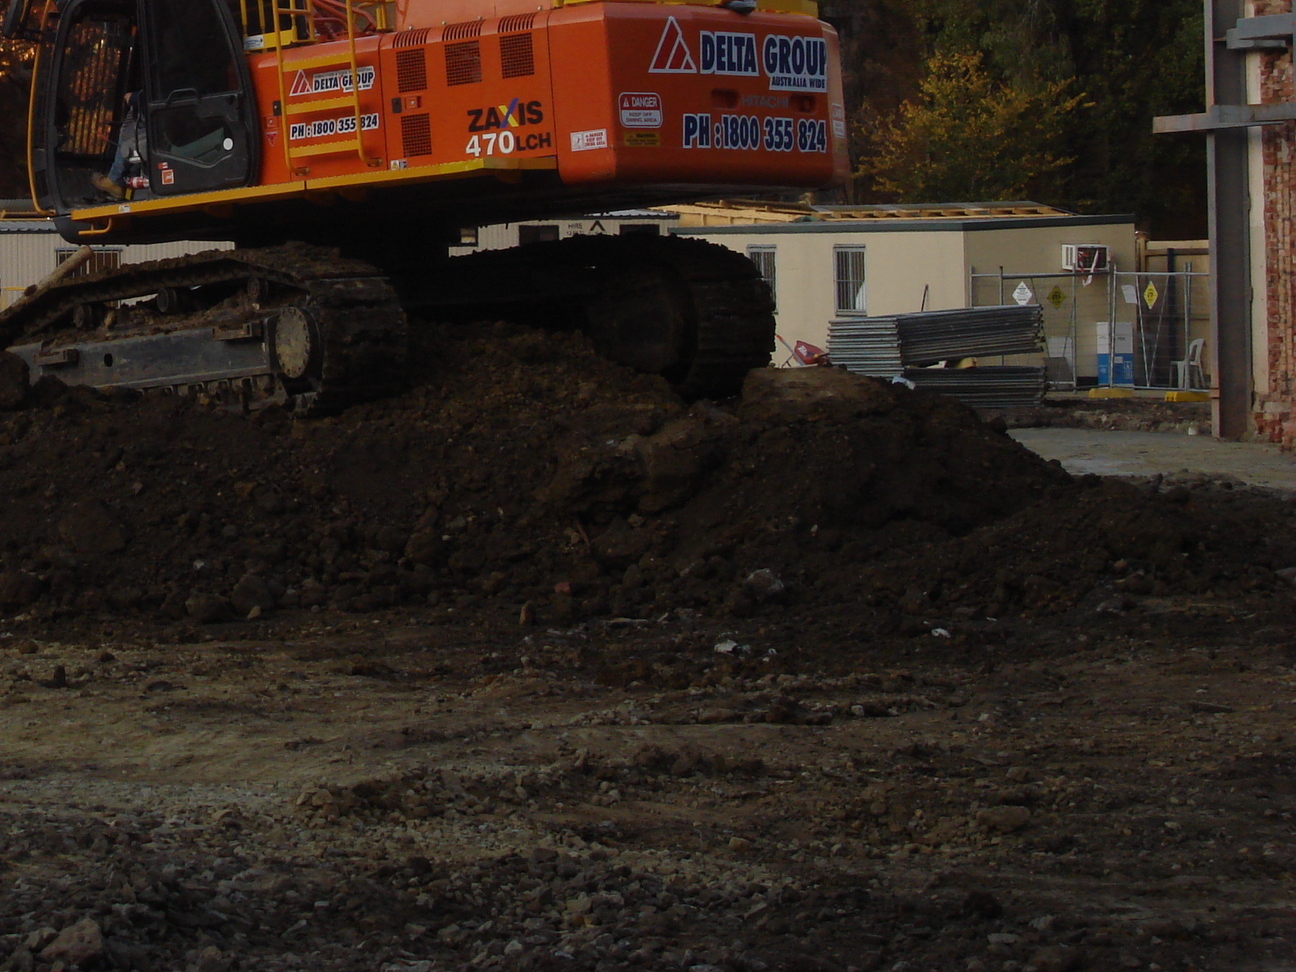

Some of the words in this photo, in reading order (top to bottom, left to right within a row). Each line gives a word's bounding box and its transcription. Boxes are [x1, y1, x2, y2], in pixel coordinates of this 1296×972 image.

[701, 33, 757, 73] DELTA
[314, 77, 339, 91] DELTA
[771, 76, 807, 87] AUSTRALIA
[809, 79, 825, 89] WIDE
[631, 97, 658, 108] DANGER
[741, 94, 789, 108] HITACHI
[467, 98, 543, 132] ZAXIS
[338, 118, 356, 132] 355
[765, 117, 793, 150] 355
[798, 120, 826, 151] 824
